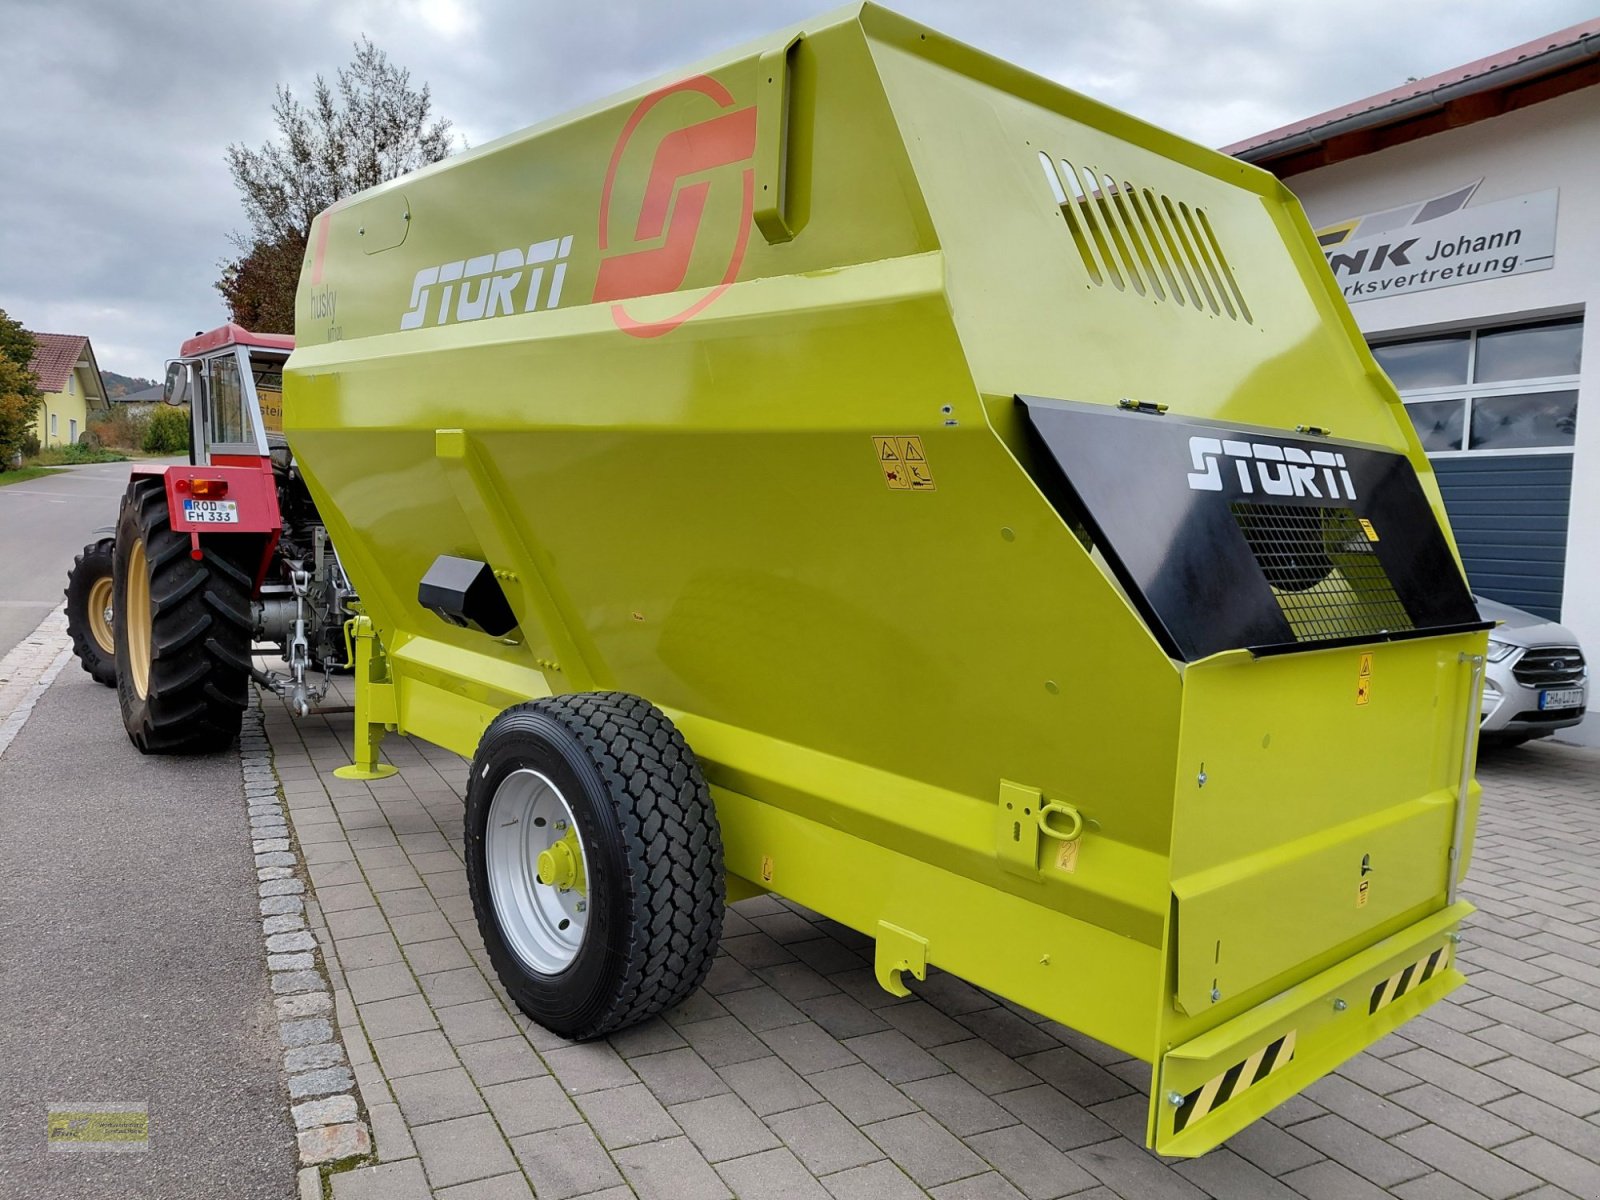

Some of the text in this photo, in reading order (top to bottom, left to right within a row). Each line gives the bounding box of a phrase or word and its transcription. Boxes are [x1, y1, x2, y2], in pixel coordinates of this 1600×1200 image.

[1425, 229, 1522, 261] Johann
[400, 235, 574, 330] STORTI
[1344, 254, 1519, 297] rksvertretung
[310, 283, 337, 325] husky
[1187, 436, 1357, 500] STORTI
[188, 511, 231, 522] FH 333
[193, 501, 217, 511] ROD
